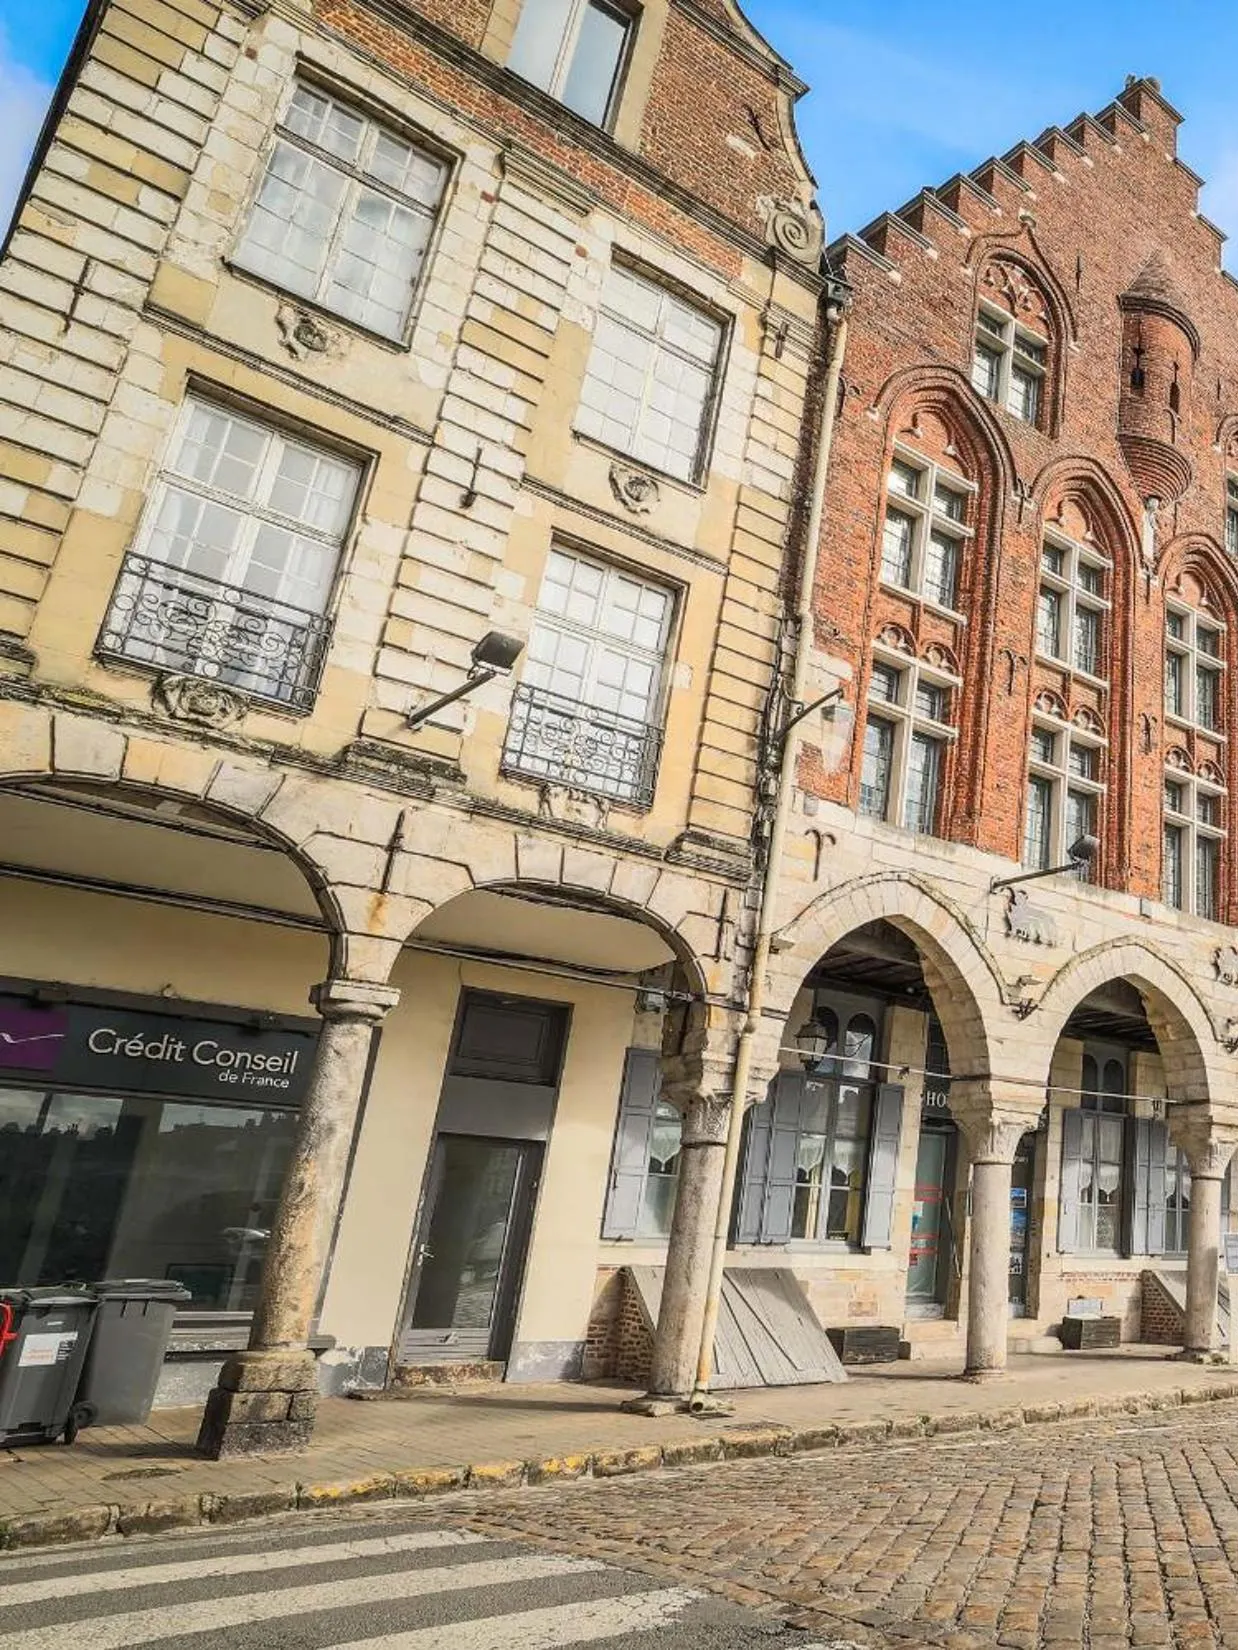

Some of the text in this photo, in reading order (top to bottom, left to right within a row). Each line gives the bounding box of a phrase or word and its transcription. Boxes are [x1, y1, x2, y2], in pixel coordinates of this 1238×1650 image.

[88, 1028, 299, 1074] Crédit Conseil
[218, 1069, 290, 1089] de France
